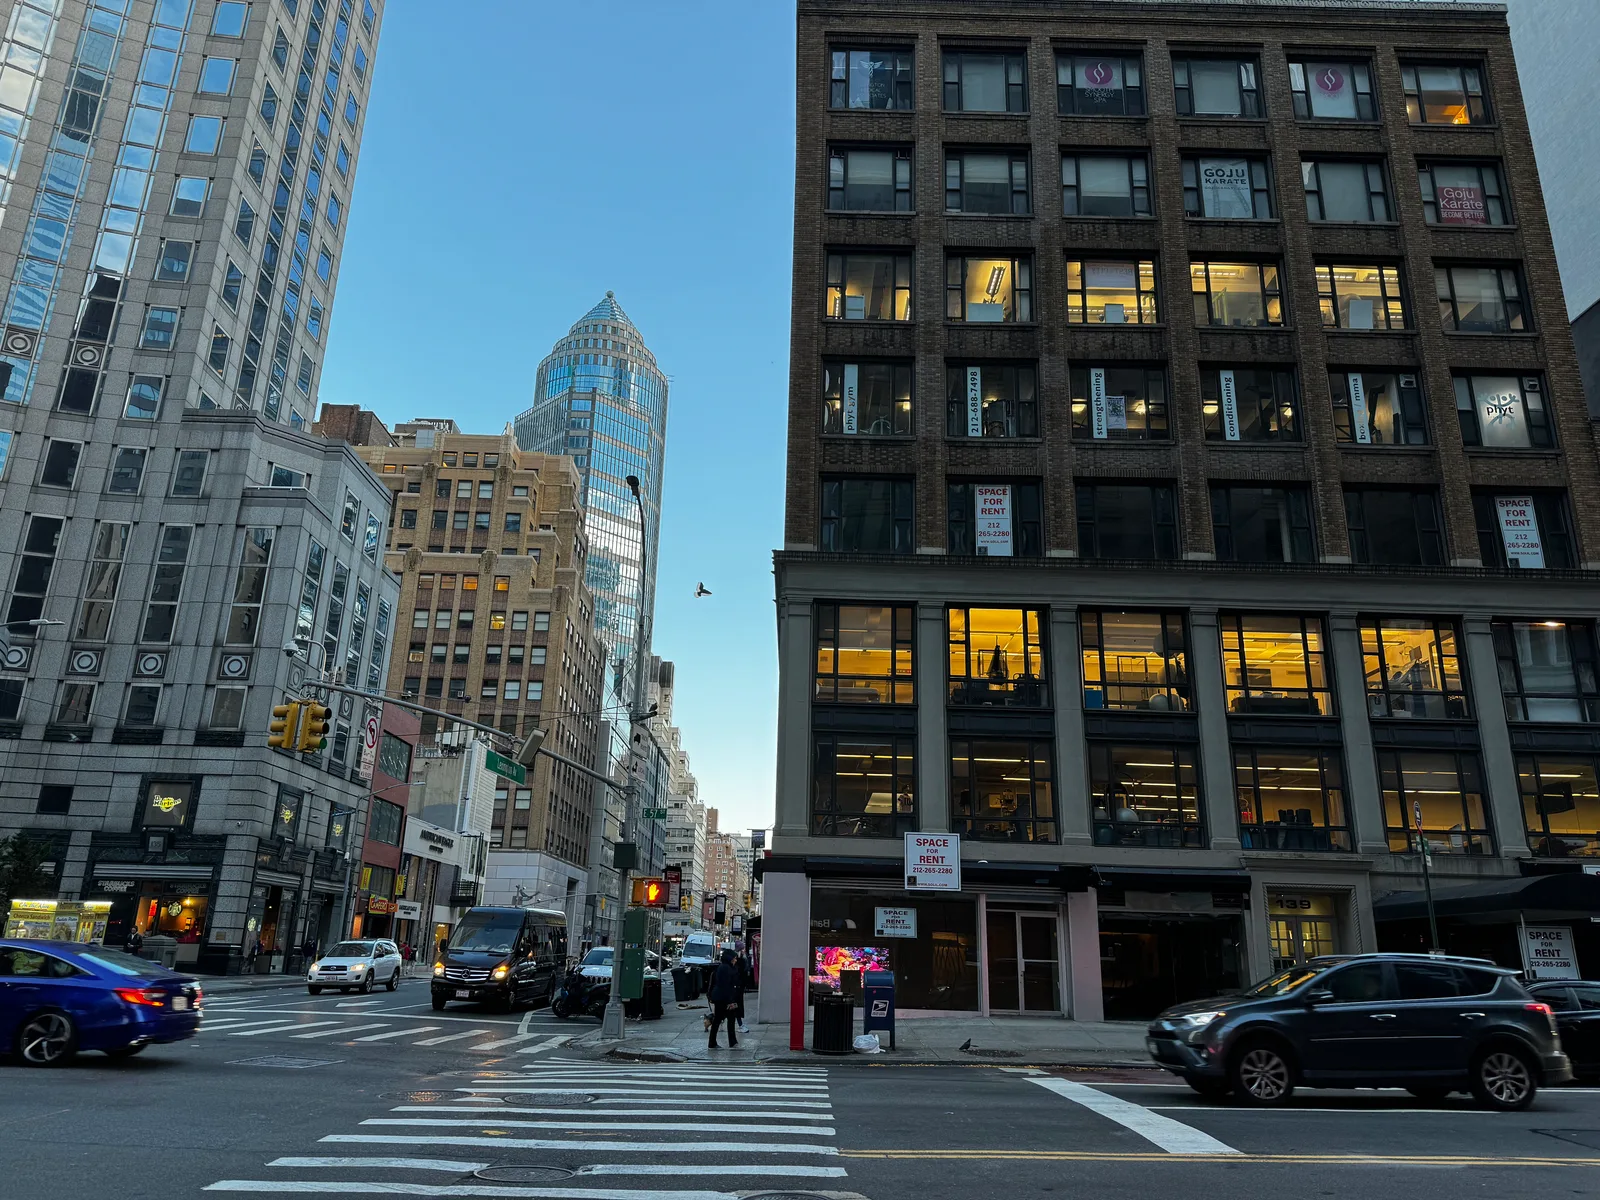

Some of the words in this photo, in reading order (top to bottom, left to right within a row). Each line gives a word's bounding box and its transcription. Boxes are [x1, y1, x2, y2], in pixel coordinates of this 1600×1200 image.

[1204, 168, 1245, 178] GOJU
[1444, 188, 1474, 200] Goju
[1440, 198, 1483, 210] Karate
[1352, 378, 1360, 401] mma
[848, 386, 856, 406] gym
[970, 371, 979, 434] 212-688-7498
[1093, 372, 1104, 436] strengthening
[1224, 377, 1236, 437] conditioning
[1486, 405, 1514, 416] phyt
[846, 410, 855, 430] phyt
[643, 808, 647, 819] E
[650, 809, 657, 819] 57
[916, 838, 948, 847] SPACE
[920, 856, 945, 864] RENT
[1276, 900, 1311, 909] 139
[1529, 932, 1562, 940] SPACE
[1535, 949, 1561, 957] RENT
